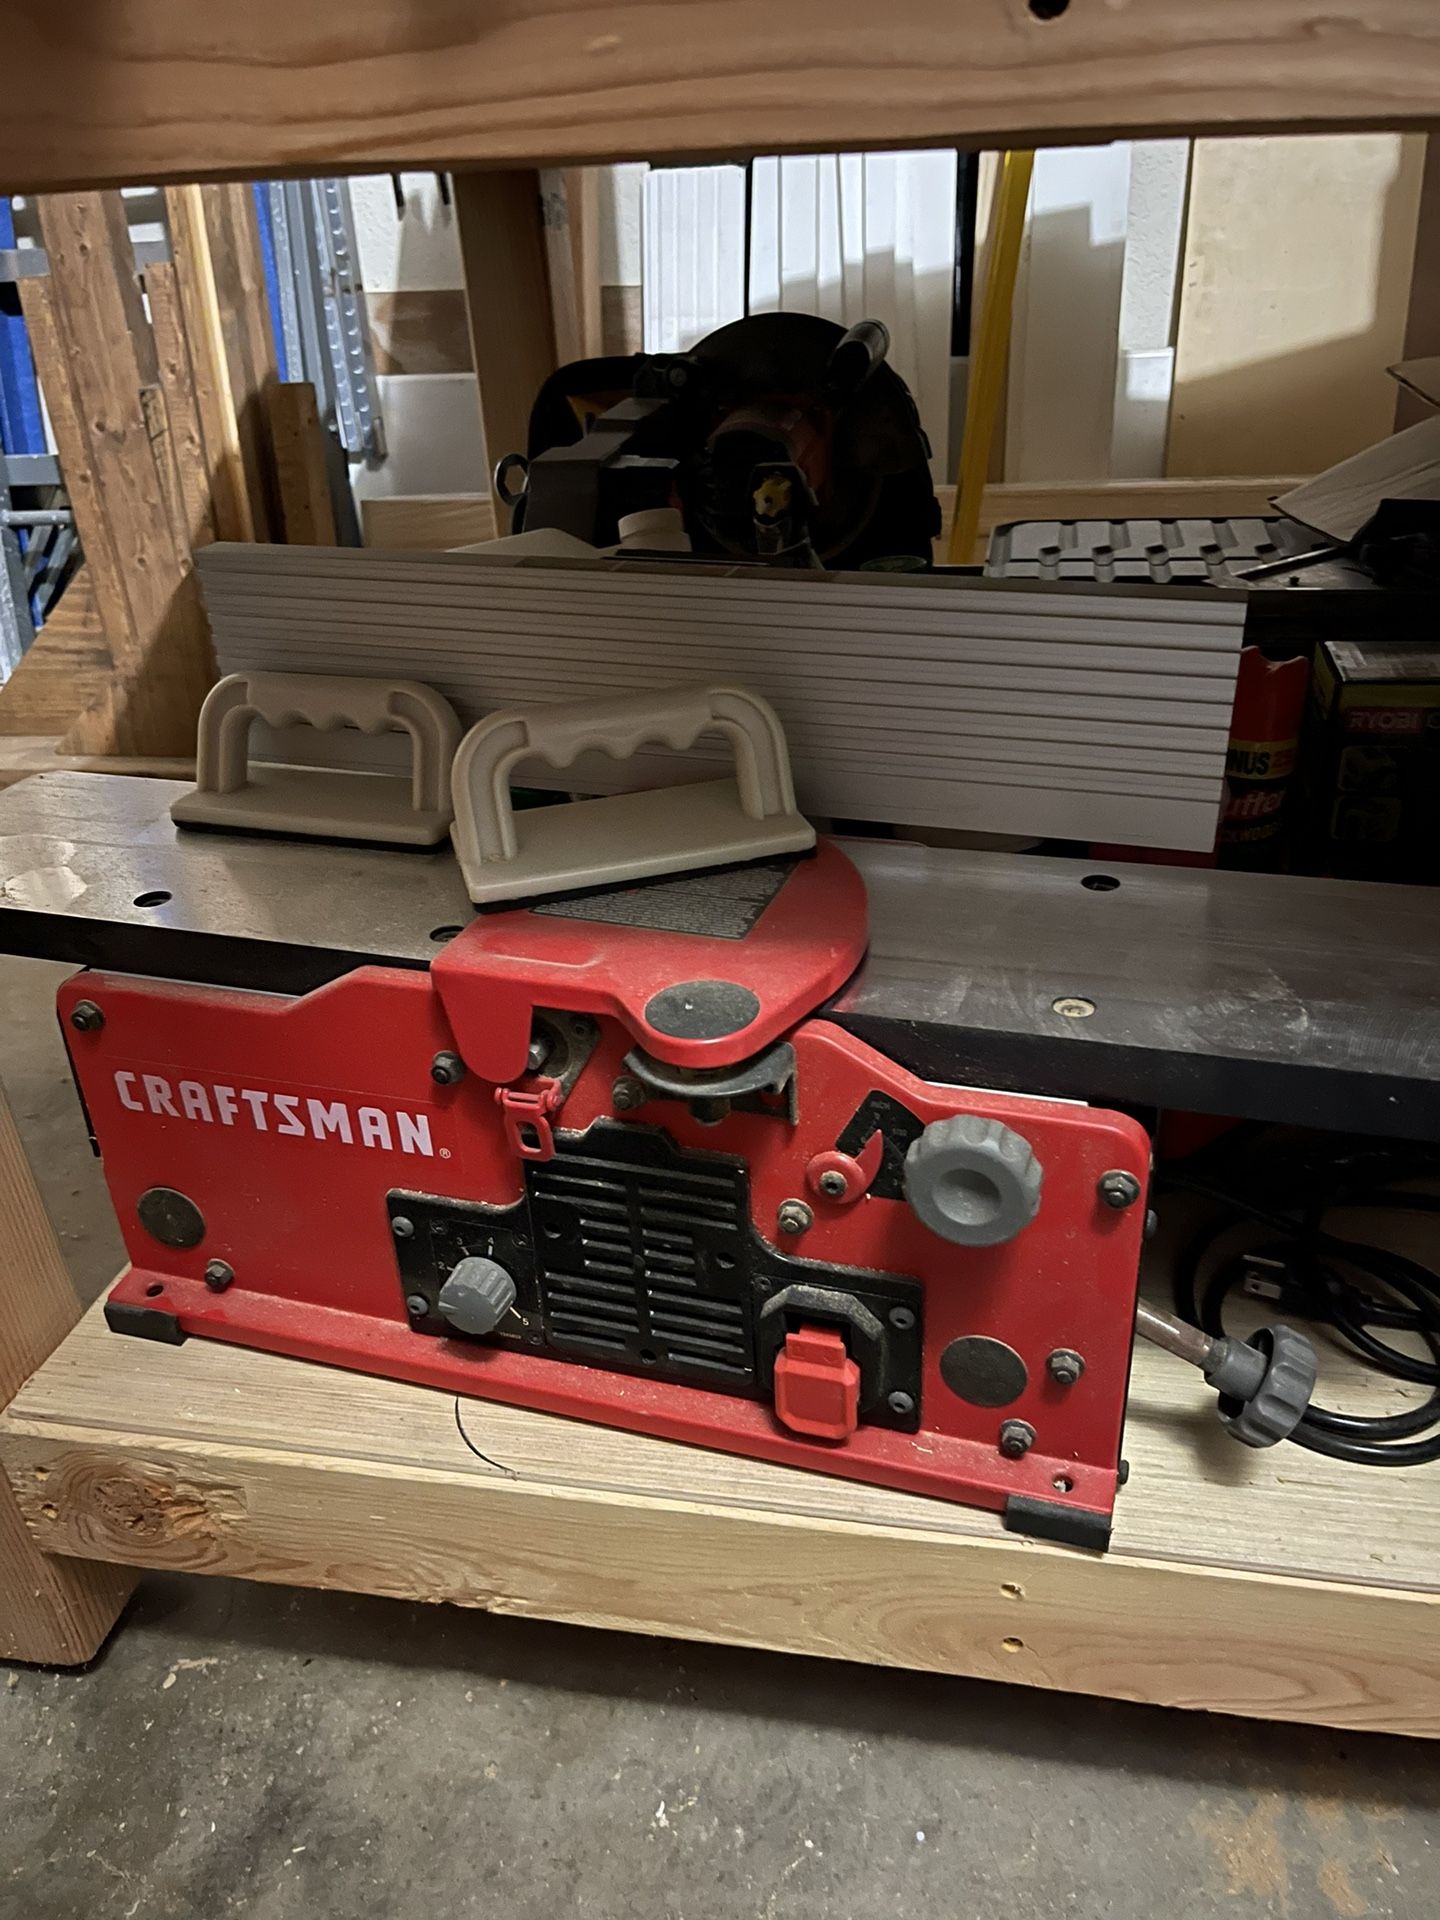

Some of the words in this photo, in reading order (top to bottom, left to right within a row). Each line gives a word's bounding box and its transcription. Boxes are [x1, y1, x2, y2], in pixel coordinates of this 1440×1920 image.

[1349, 711, 1418, 729] RYOBI
[114, 1070, 434, 1157] CRAFTSMAN
[456, 1236, 463, 1245] 3
[488, 1236, 494, 1245] 4
[438, 1261, 445, 1270] 2
[522, 1317, 529, 1326] 5
